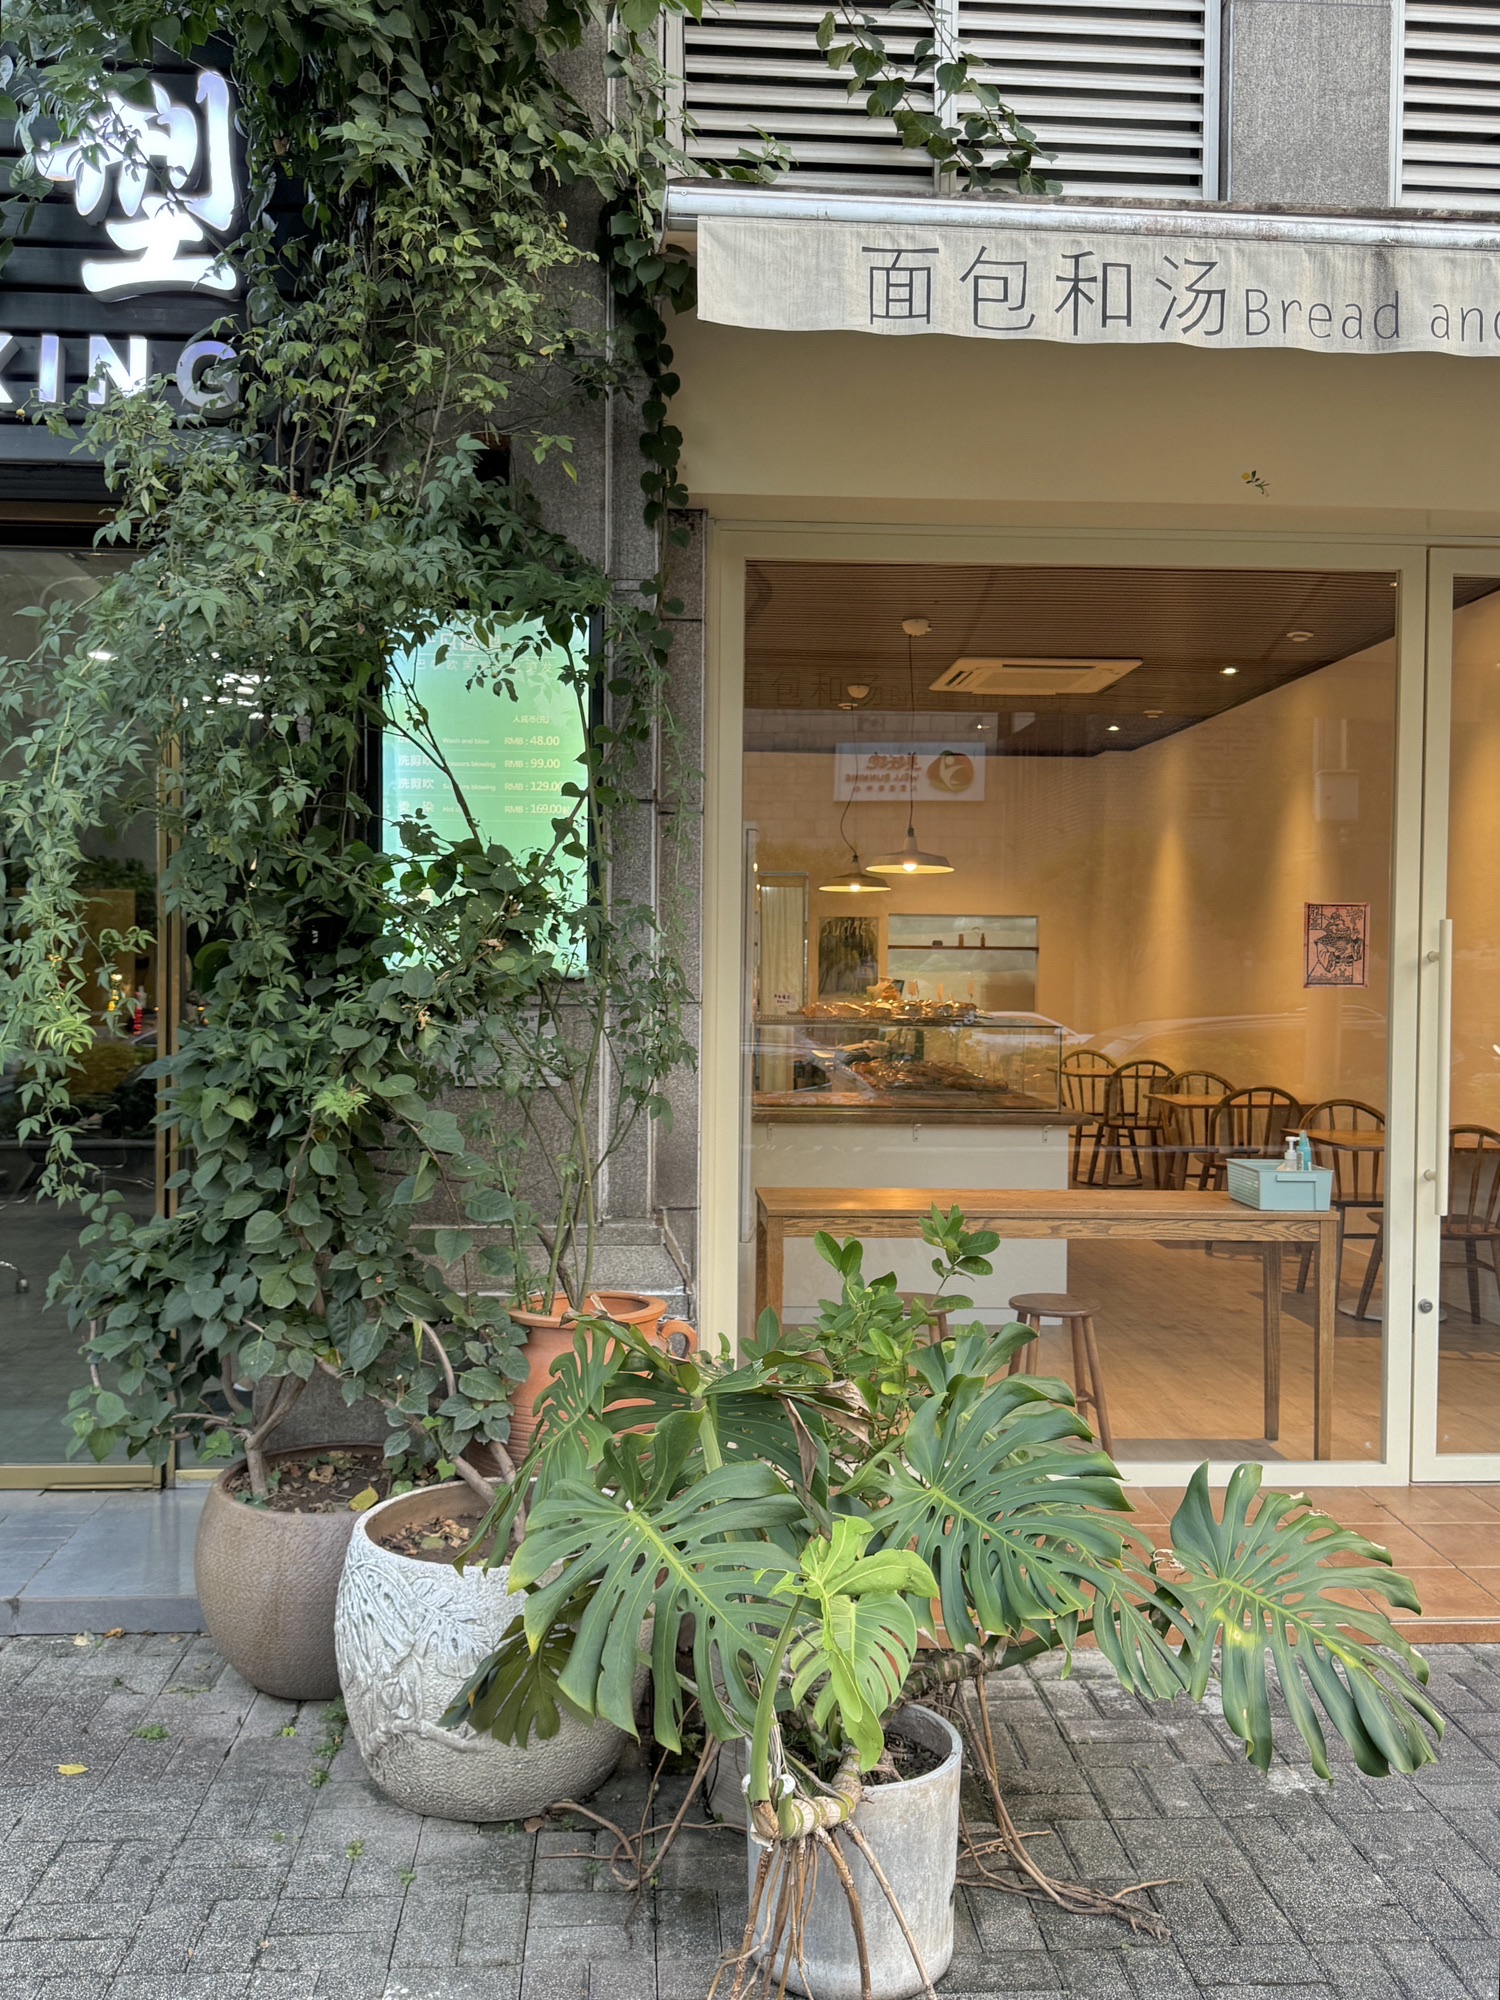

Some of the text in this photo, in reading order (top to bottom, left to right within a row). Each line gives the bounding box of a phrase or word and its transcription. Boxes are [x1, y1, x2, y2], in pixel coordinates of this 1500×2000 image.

[860, 245, 1500, 343] 面包和汤 Bread an
[442, 737, 460, 745] Wash
[461, 737, 473, 745] and
[474, 737, 490, 745] blow
[398, 777, 435, 790] 洗剪吹
